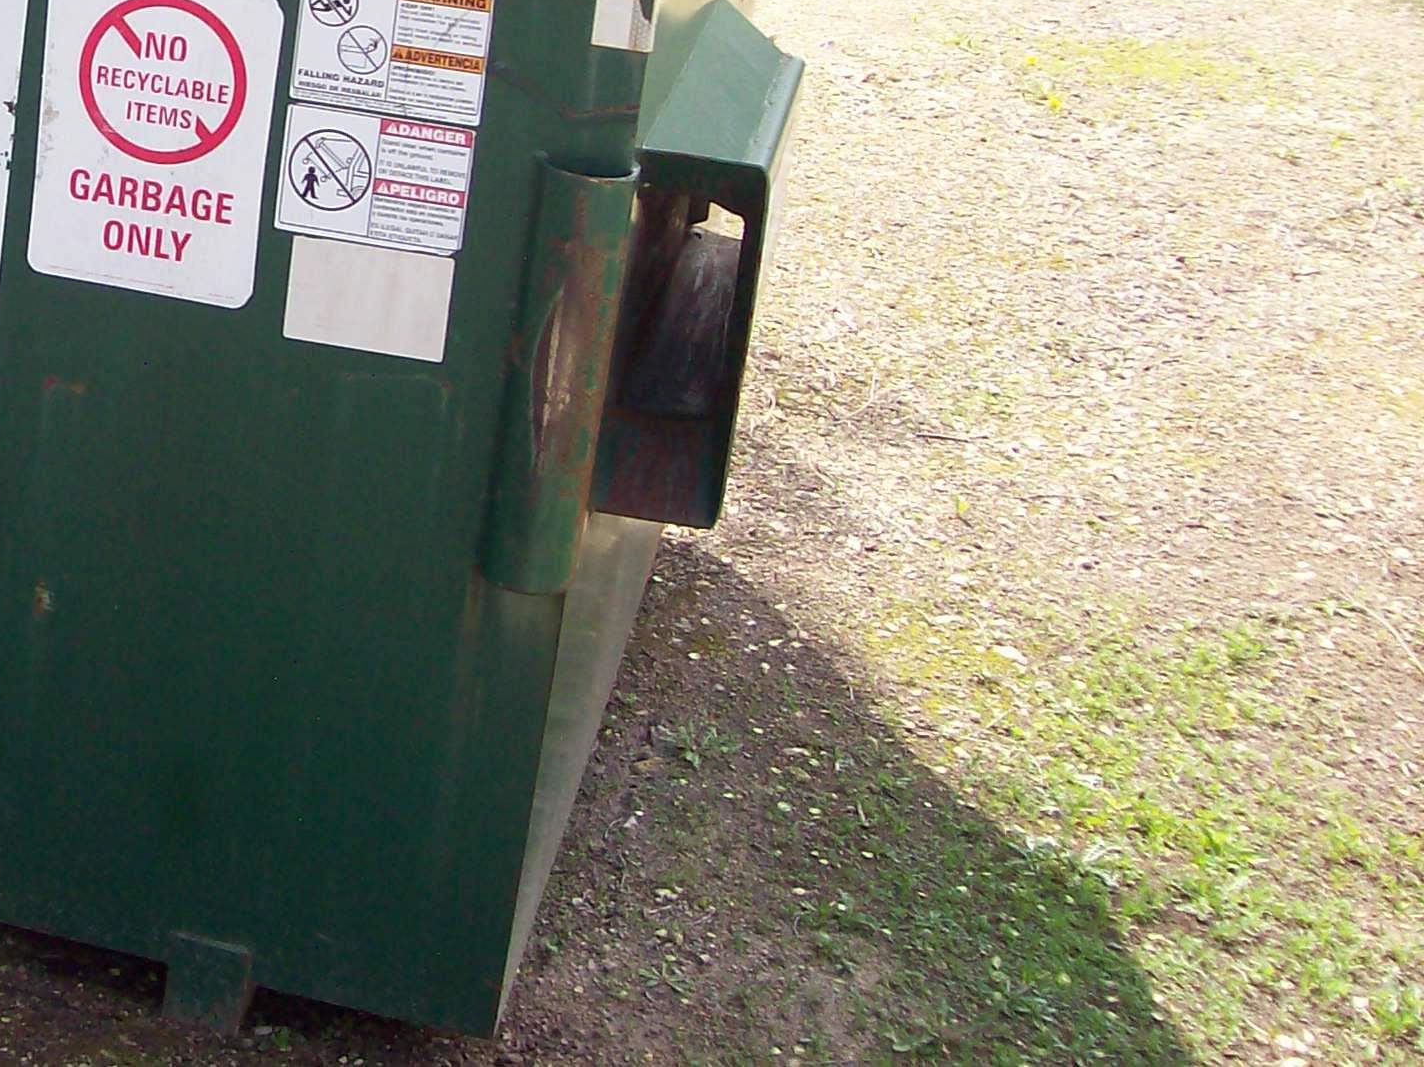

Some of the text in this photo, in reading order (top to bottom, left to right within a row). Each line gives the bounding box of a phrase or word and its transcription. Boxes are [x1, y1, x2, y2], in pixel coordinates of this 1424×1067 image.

[145, 32, 188, 62] NO
[406, 51, 481, 70] ADVERTENCIA
[96, 65, 230, 105] RECYCLABLE
[298, 68, 385, 88] FALLING HAZARD
[126, 101, 192, 129] ITEMS
[398, 124, 466, 145] DANGER
[69, 168, 234, 225] GARBAGE
[390, 184, 460, 205] PELIGRO
[103, 219, 192, 262] ONLY
